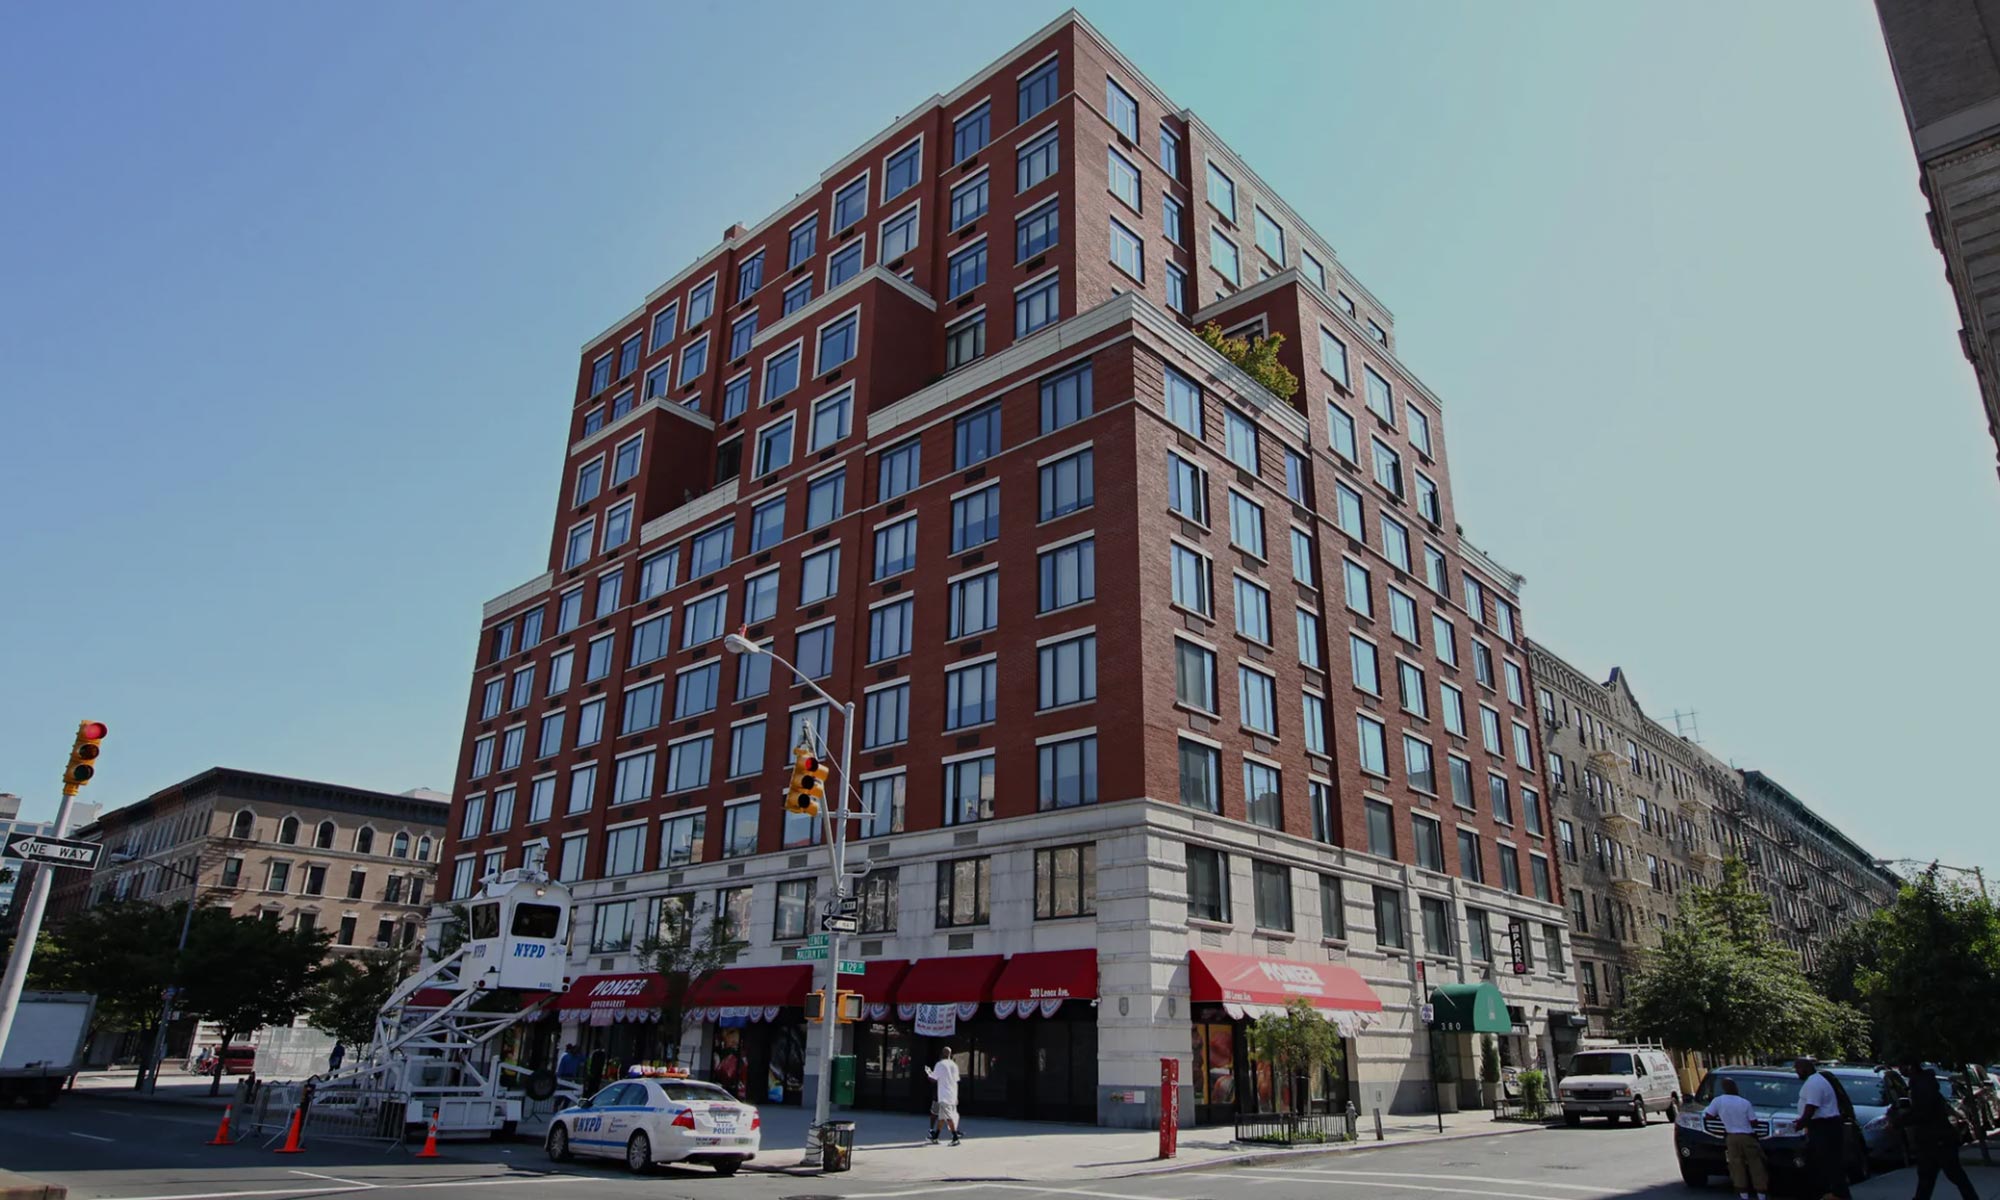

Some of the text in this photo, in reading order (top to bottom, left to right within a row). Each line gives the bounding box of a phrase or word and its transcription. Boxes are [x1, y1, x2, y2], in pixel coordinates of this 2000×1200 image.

[20, 841, 88, 860] ONE WAY
[513, 942, 546, 959] NYPD
[1512, 933, 1523, 963] PARK
[846, 961, 857, 972] 129
[588, 978, 649, 997] PIONEER
[1040, 988, 1057, 998] Lenox
[577, 1116, 602, 1133] NYPD
[713, 1127, 736, 1135] POLICE
